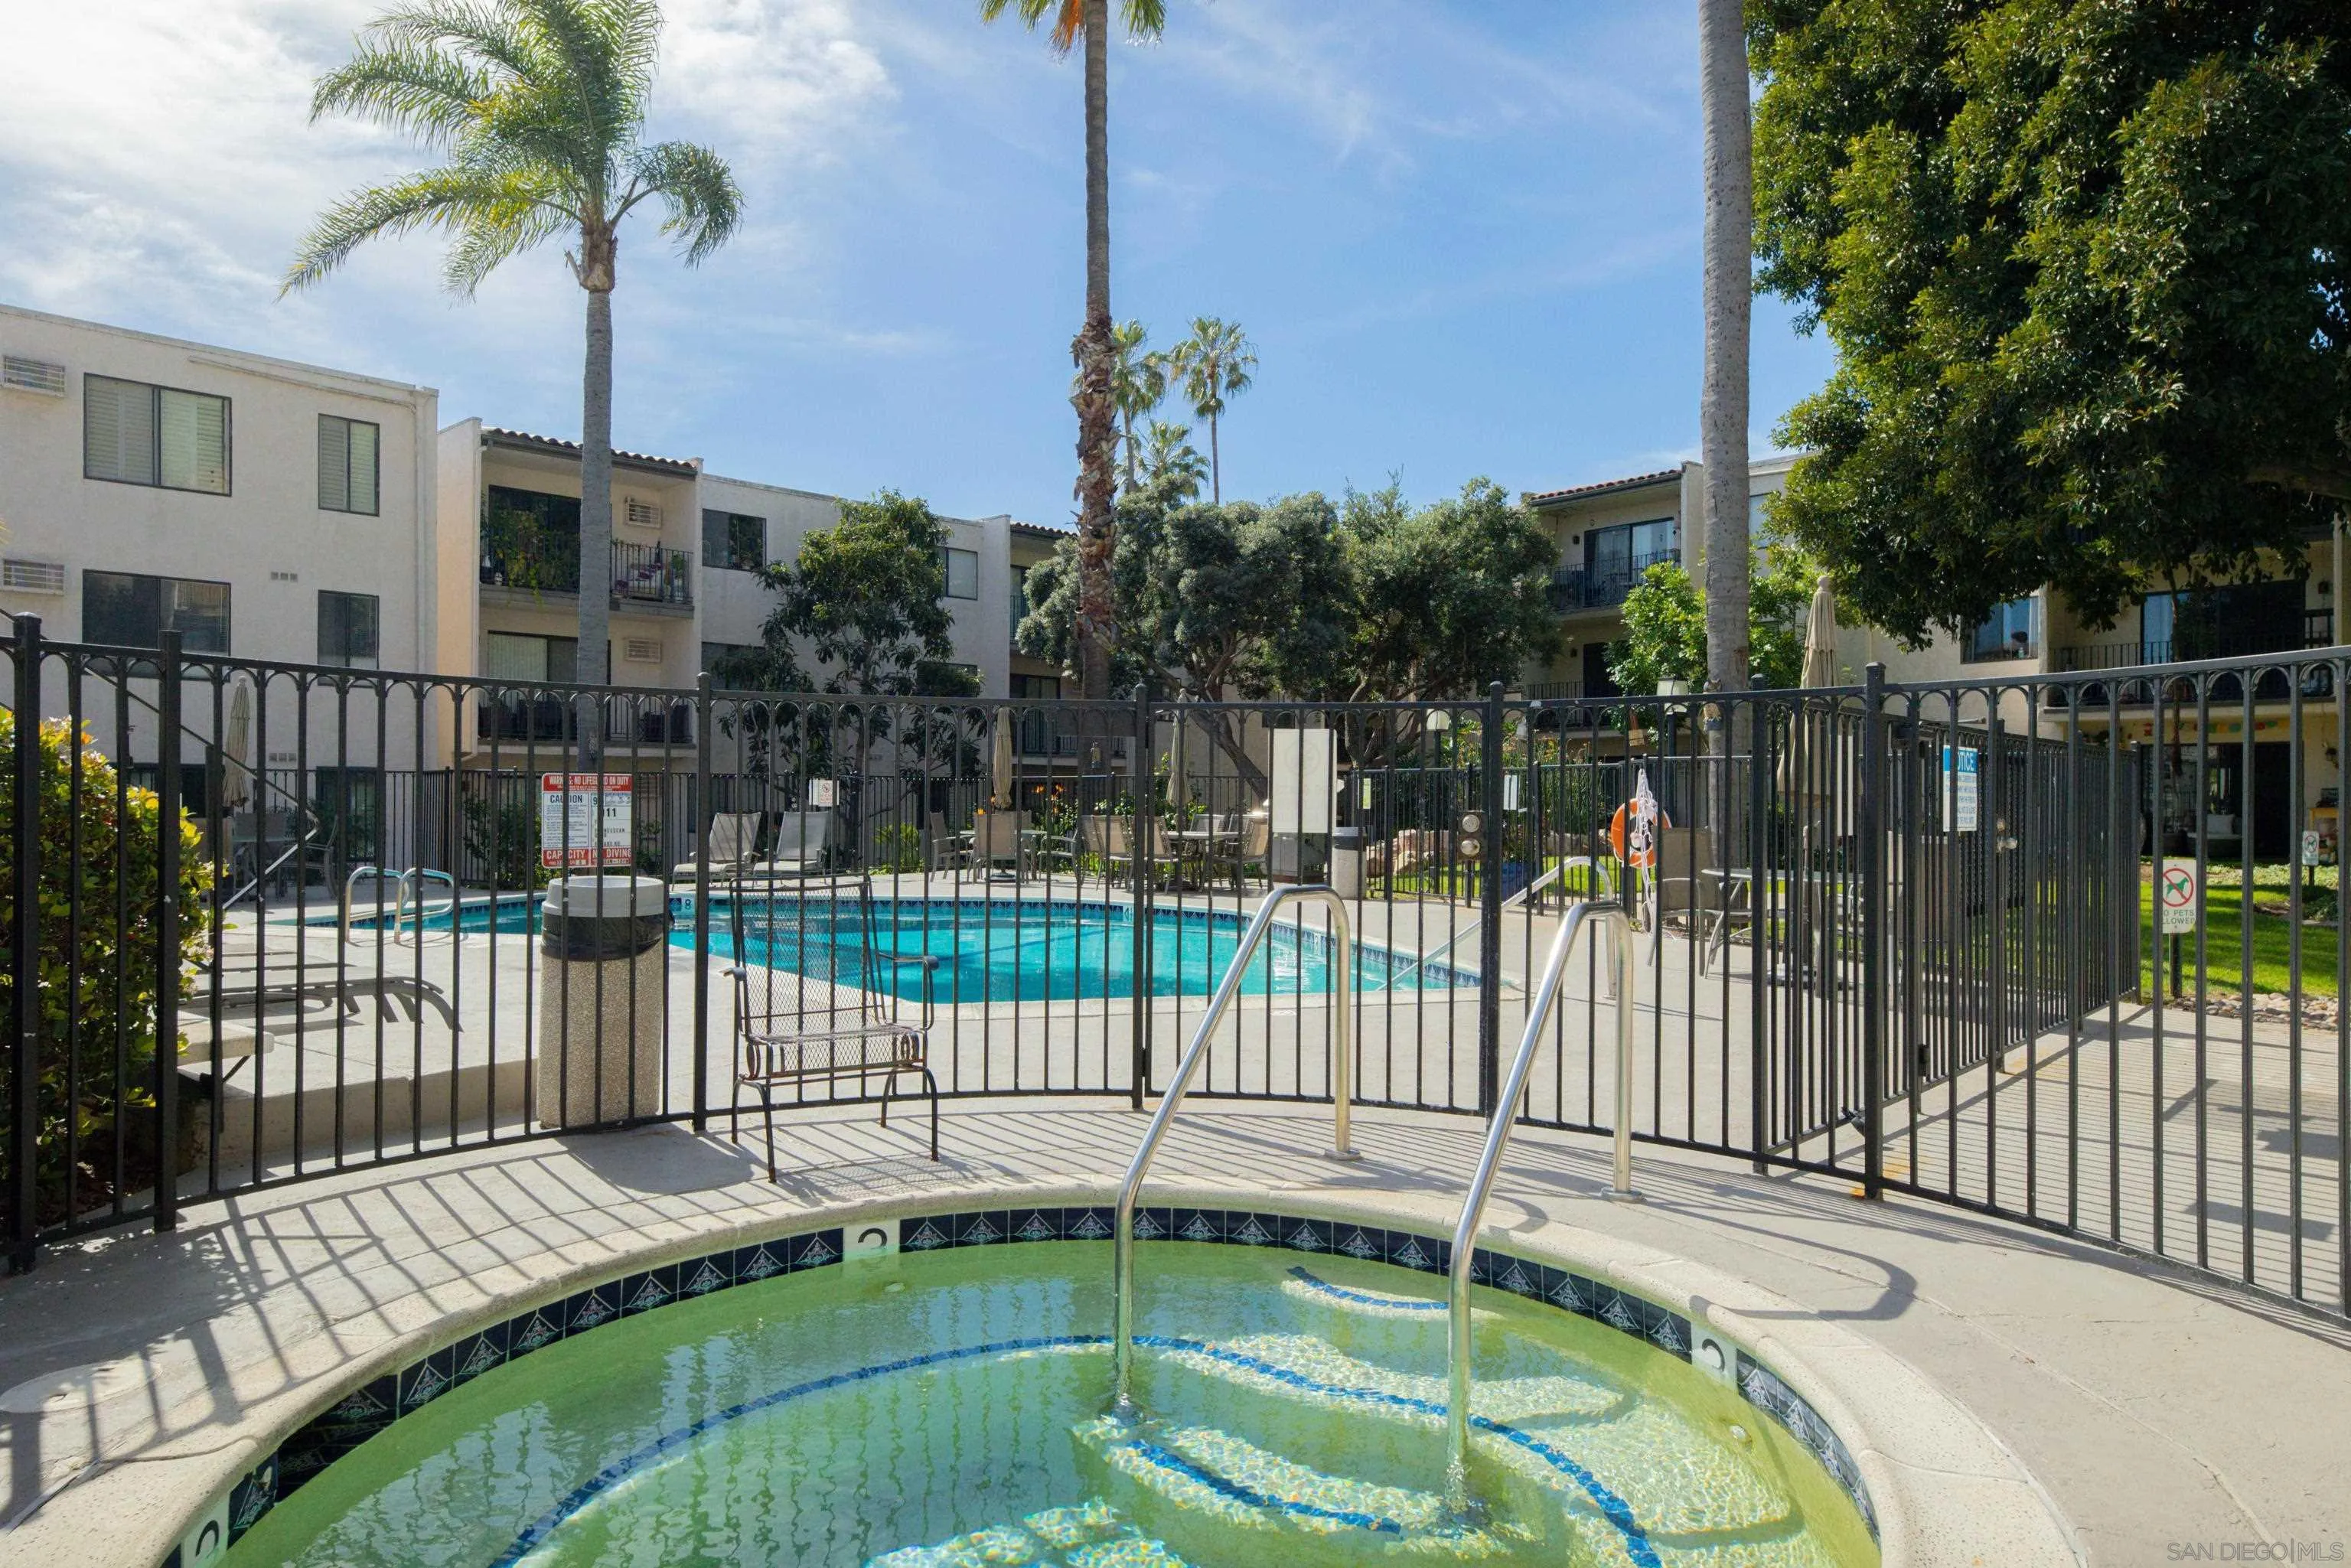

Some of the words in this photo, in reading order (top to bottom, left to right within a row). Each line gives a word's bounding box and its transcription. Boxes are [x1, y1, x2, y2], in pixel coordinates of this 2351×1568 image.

[549, 776, 572, 784] WARNG:
[550, 794, 582, 804] CAUION
[546, 849, 585, 859] CAPCITY
